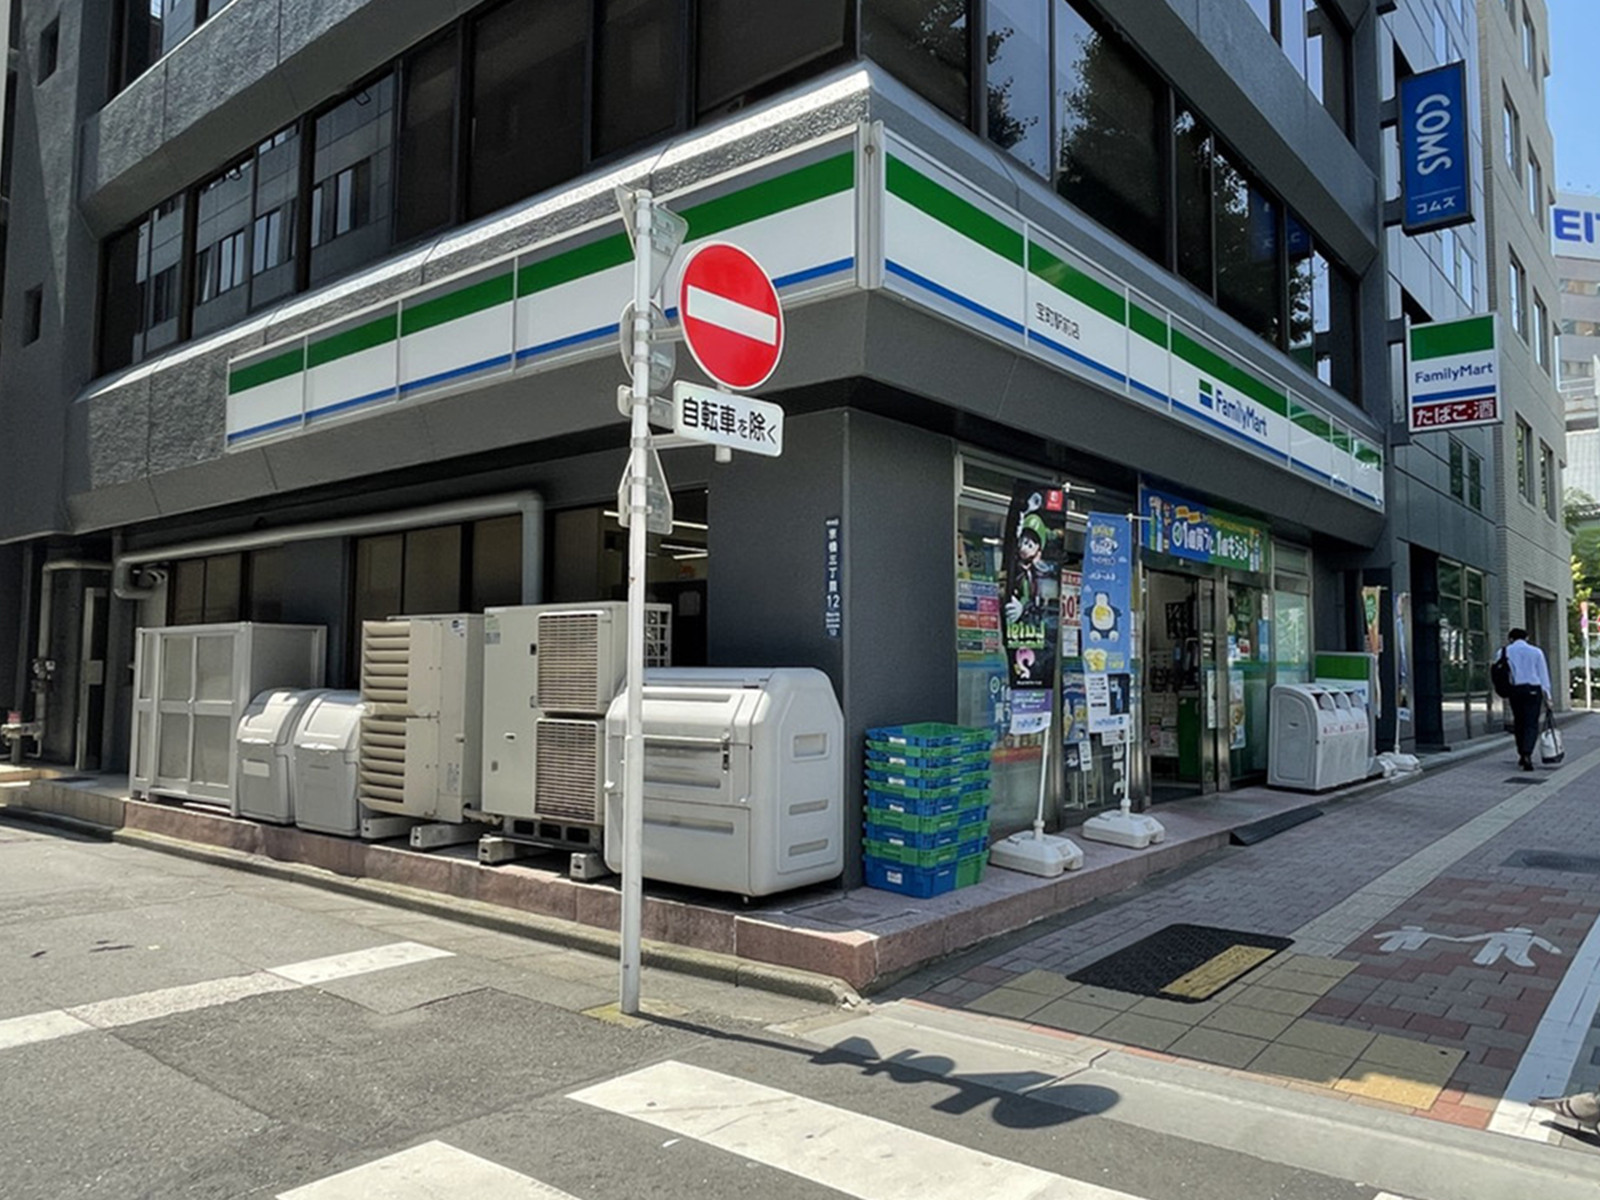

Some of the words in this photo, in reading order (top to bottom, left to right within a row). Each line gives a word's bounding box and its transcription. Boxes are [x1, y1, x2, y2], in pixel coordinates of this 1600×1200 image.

[1415, 93, 1452, 176] COMS
[1416, 195, 1457, 215] コムス
[1415, 362, 1493, 383] FamilyMart
[682, 396, 777, 445] 自転車を除く
[1215, 389, 1268, 437] FamilyMart
[1416, 399, 1494, 426] たばこ・酒
